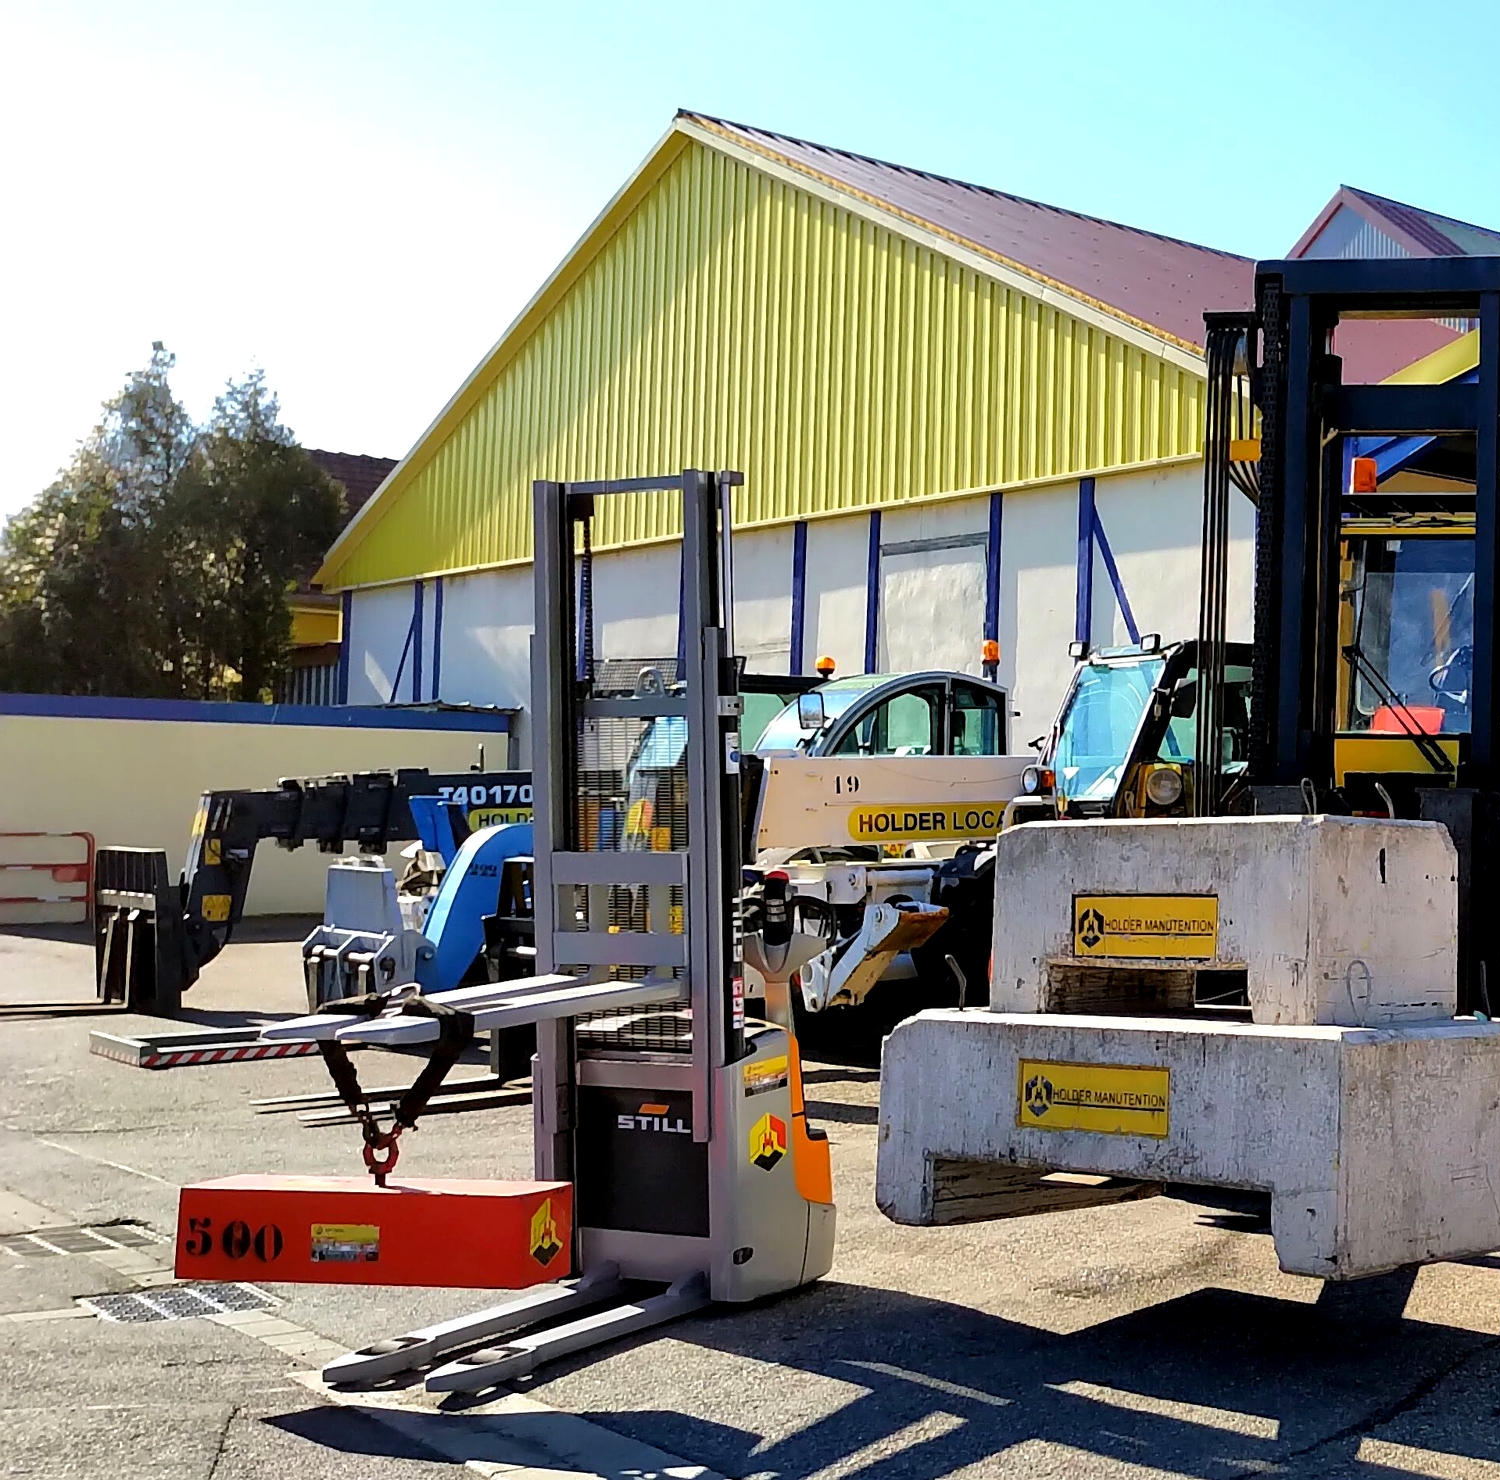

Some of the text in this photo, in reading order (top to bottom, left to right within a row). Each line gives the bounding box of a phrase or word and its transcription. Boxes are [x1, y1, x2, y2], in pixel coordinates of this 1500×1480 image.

[836, 775, 860, 794] 19
[438, 784, 534, 805] T40170
[478, 812, 534, 829] HOLD
[858, 811, 946, 833] HOLDER
[1105, 918, 1215, 932] HOLDER MANUTENTION
[1053, 1088, 1166, 1107] HOLDER MANUTENTION
[617, 1114, 692, 1134] STILL
[185, 1217, 284, 1263] 500
